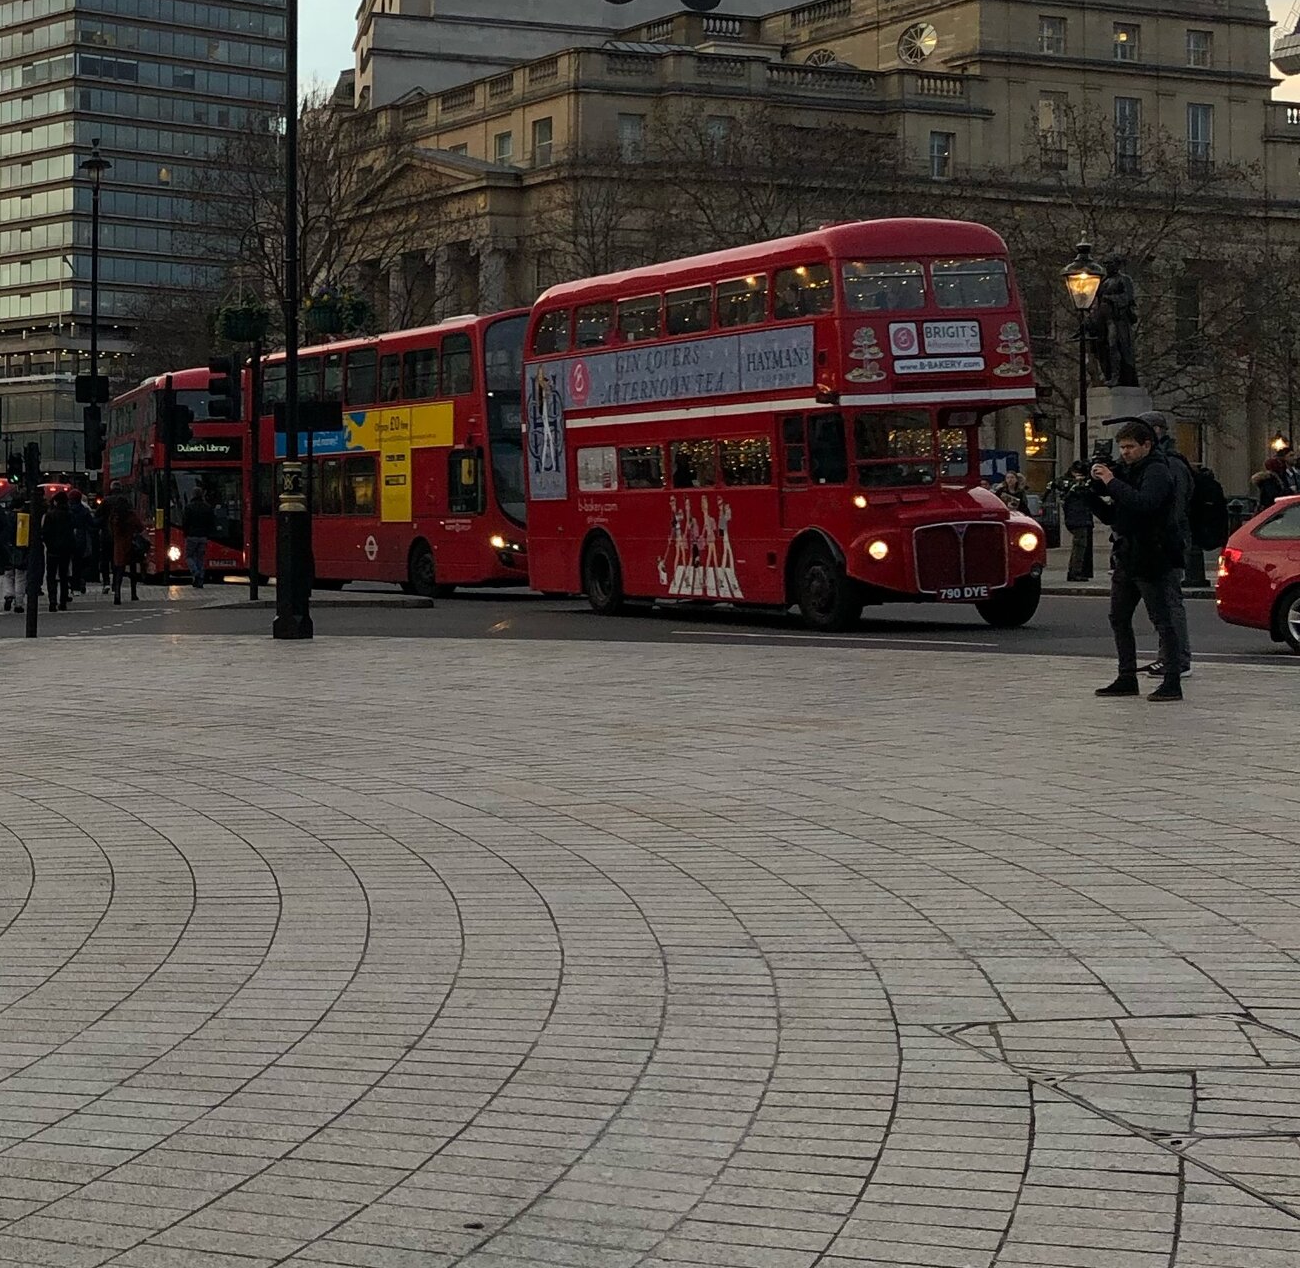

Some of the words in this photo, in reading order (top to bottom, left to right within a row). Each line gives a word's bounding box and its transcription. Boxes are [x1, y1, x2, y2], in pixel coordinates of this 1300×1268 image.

[925, 325, 978, 339] BRIGIT'S
[617, 353, 641, 374] GIN
[695, 372, 724, 394] TEA
[176, 443, 205, 452] Dulwich
[206, 443, 231, 454] Library
[939, 588, 961, 599] 790
[963, 585, 989, 598] DYE
